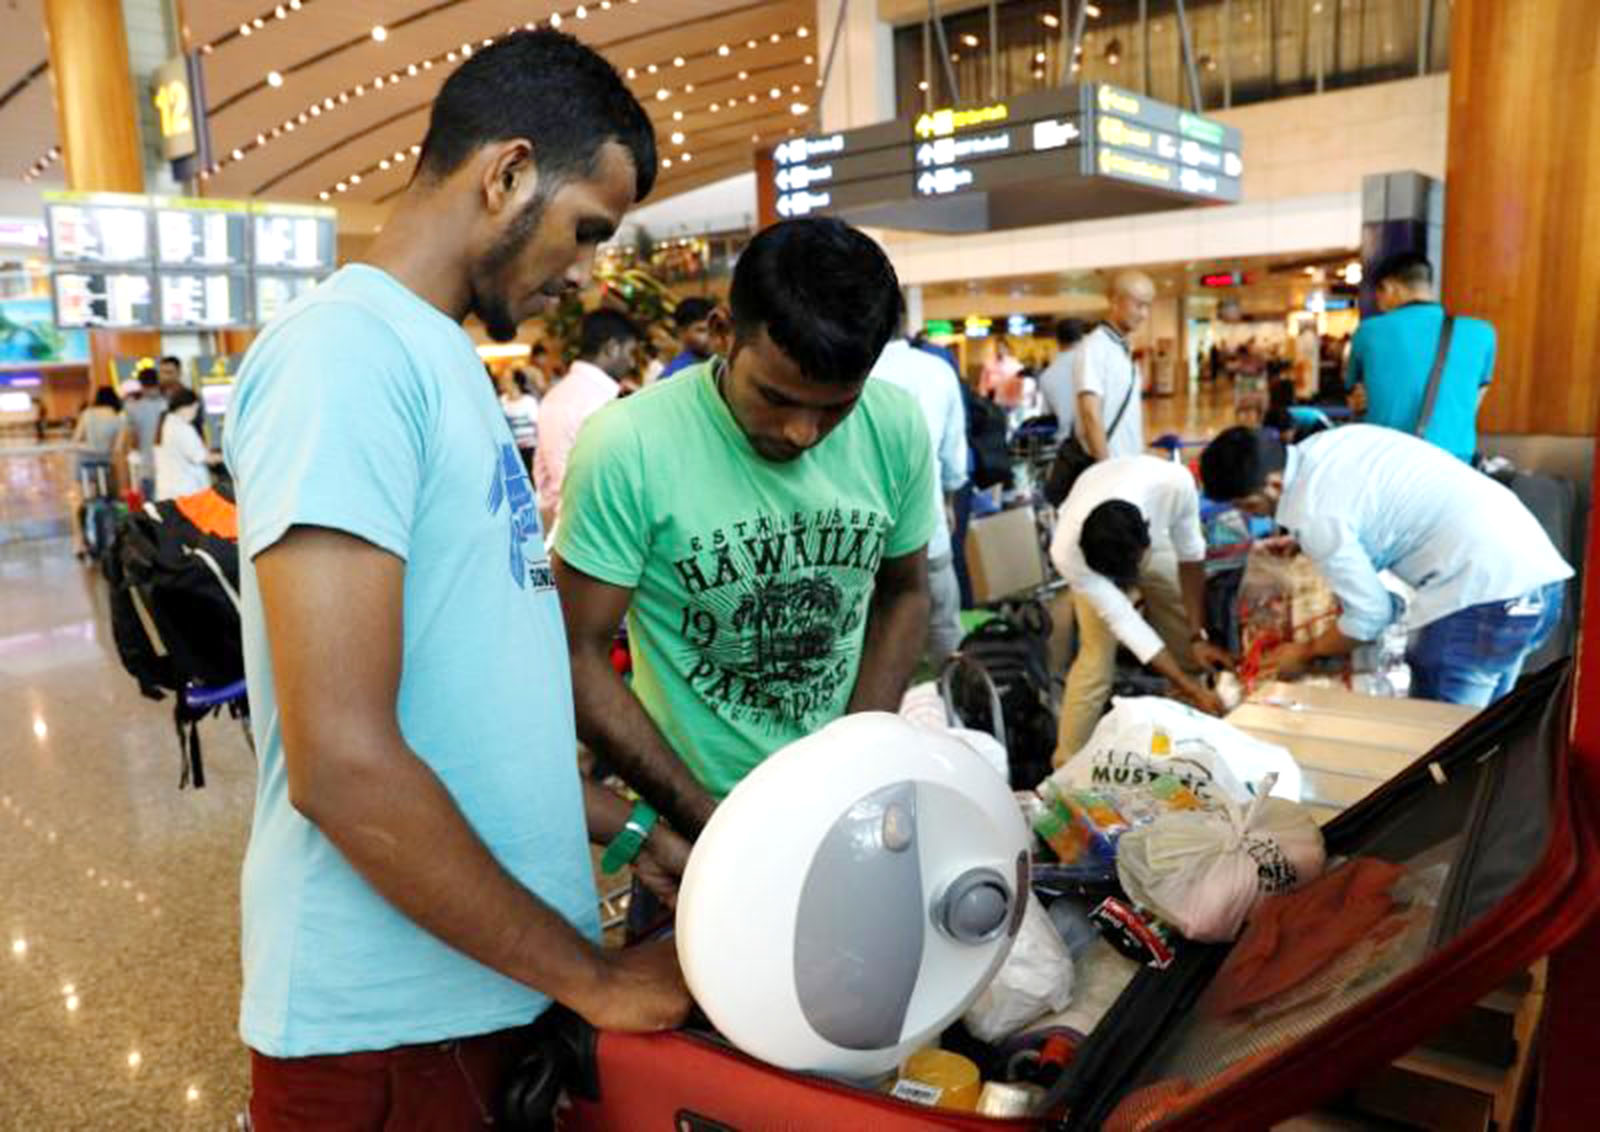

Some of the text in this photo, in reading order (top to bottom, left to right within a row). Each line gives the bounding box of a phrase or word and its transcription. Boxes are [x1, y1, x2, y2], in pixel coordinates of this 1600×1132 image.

[155, 81, 191, 136] 12
[681, 606, 717, 648] 19
[1091, 765, 1212, 799] MUSTG
